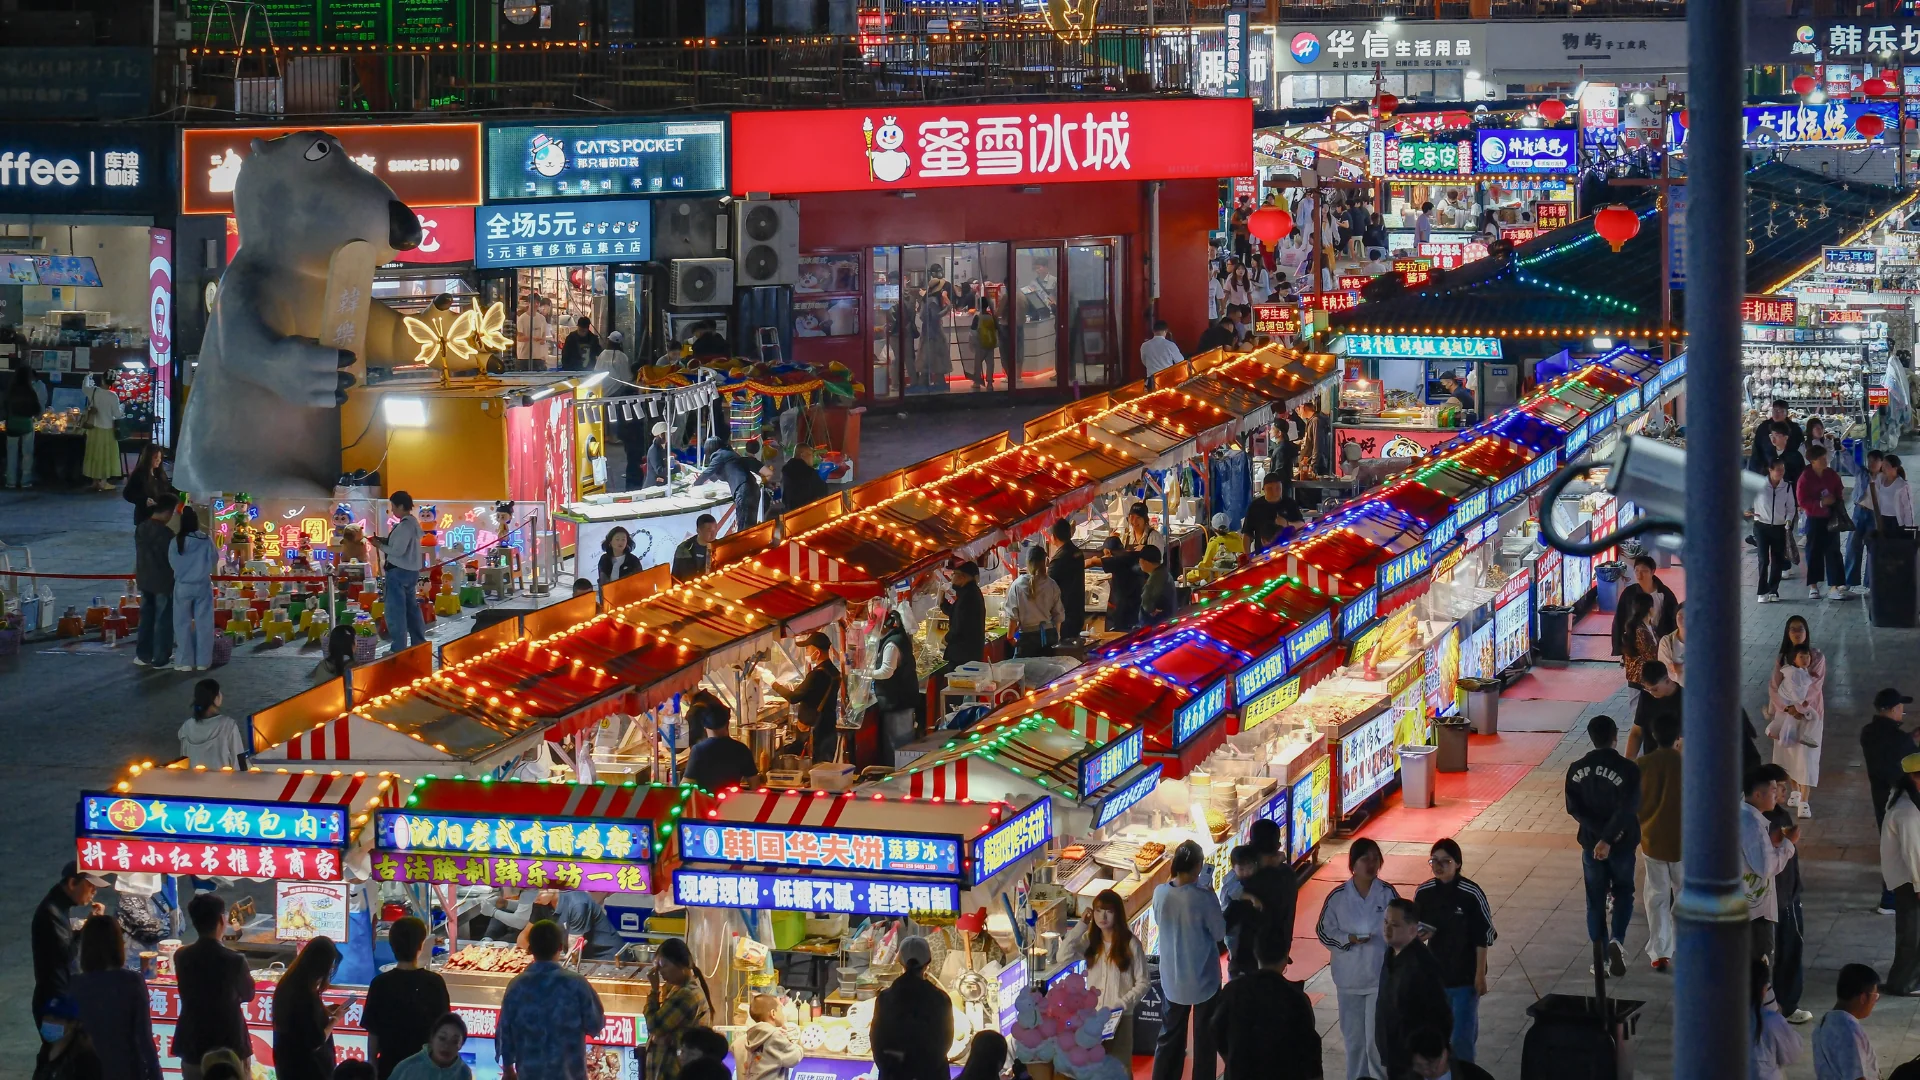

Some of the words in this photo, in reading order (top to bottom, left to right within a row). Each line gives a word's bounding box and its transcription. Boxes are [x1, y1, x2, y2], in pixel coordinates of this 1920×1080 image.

[1326, 29, 1390, 59] 华信
[1395, 39, 1471, 57] 生活用品
[1562, 32, 1602, 51] 物屿
[1605, 39, 1648, 51] 手工皮具
[576, 140, 620, 155] CAT'S
[622, 138, 684, 153] POCKET
[917, 111, 1132, 178] 蜜雪冰城
[105, 151, 140, 169] 库迪
[577, 157, 640, 169] 那只猫的口袋
[1263, 142, 1351, 178] 网红打地
[1386, 139, 1399, 171] 火鸡面
[1399, 145, 1458, 168] 卷凉皮
[388, 159, 430, 173] SINCE
[105, 169, 140, 187] 咖啡
[1538, 205, 1567, 217] 花甲粉
[486, 211, 577, 240] 全场5元
[1501, 229, 1534, 242] 广东肠粉
[488, 240, 641, 260] 5元非奢侈饰品集合店
[1826, 251, 1875, 262] 十元耳饰
[1394, 262, 1429, 273] 辛拉面
[1826, 262, 1876, 273] 小红书推荐
[1321, 294, 1355, 311] 羊肉大串
[1260, 309, 1290, 321] 烤生蚝
[1742, 302, 1795, 325] 手机贴膜
[1829, 311, 1863, 323] 冰箱贴
[1255, 320, 1294, 333] 鸡翅包饭
[1595, 765, 1623, 787] CLUB
[147, 799, 318, 841] 气泡锅包肉
[409, 814, 634, 860] 沈阳老式喷醋鸡架
[722, 826, 885, 871] 韩国华夫饼
[888, 838, 938, 861] 菠萝冰
[82, 841, 338, 881] 抖音小红书推荐商家
[373, 854, 648, 892] 古法腌制韩乐坊一绝
[594, 1017, 633, 1045] 元2份
